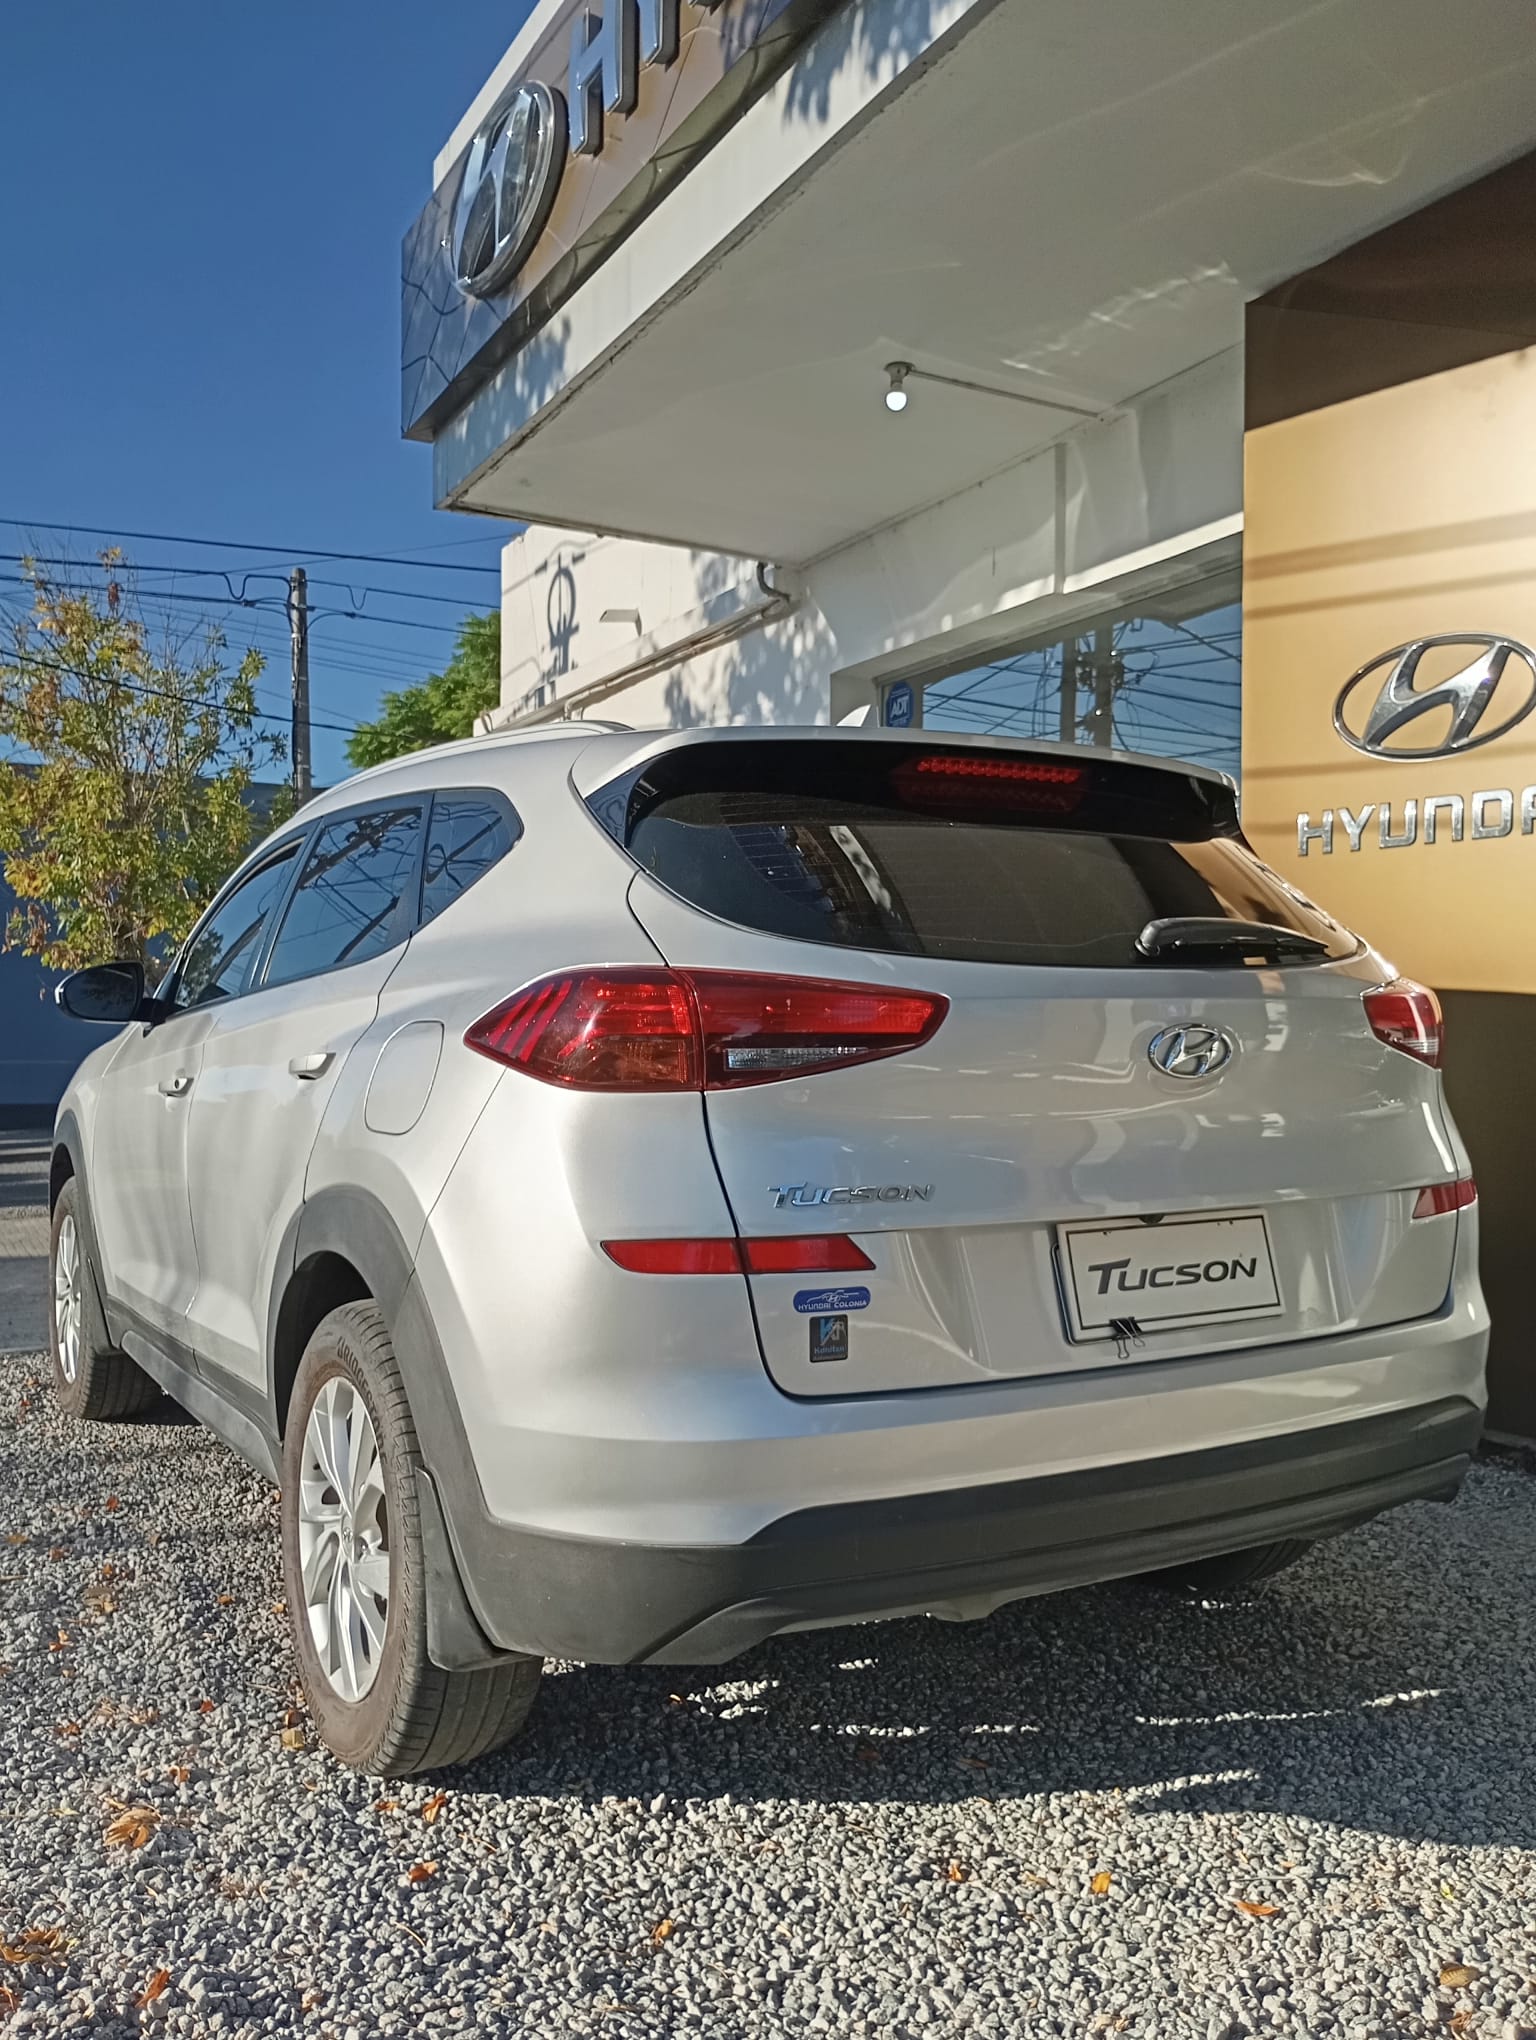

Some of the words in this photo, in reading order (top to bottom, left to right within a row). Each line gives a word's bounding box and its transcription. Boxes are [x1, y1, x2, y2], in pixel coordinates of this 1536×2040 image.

[889, 695, 910, 718] ADT
[767, 1181, 935, 1208] TUCSON
[1088, 1257, 1257, 1295] TUCSON
[798, 1302, 831, 1311] HYUNDAI
[833, 1300, 867, 1308] COLONIA
